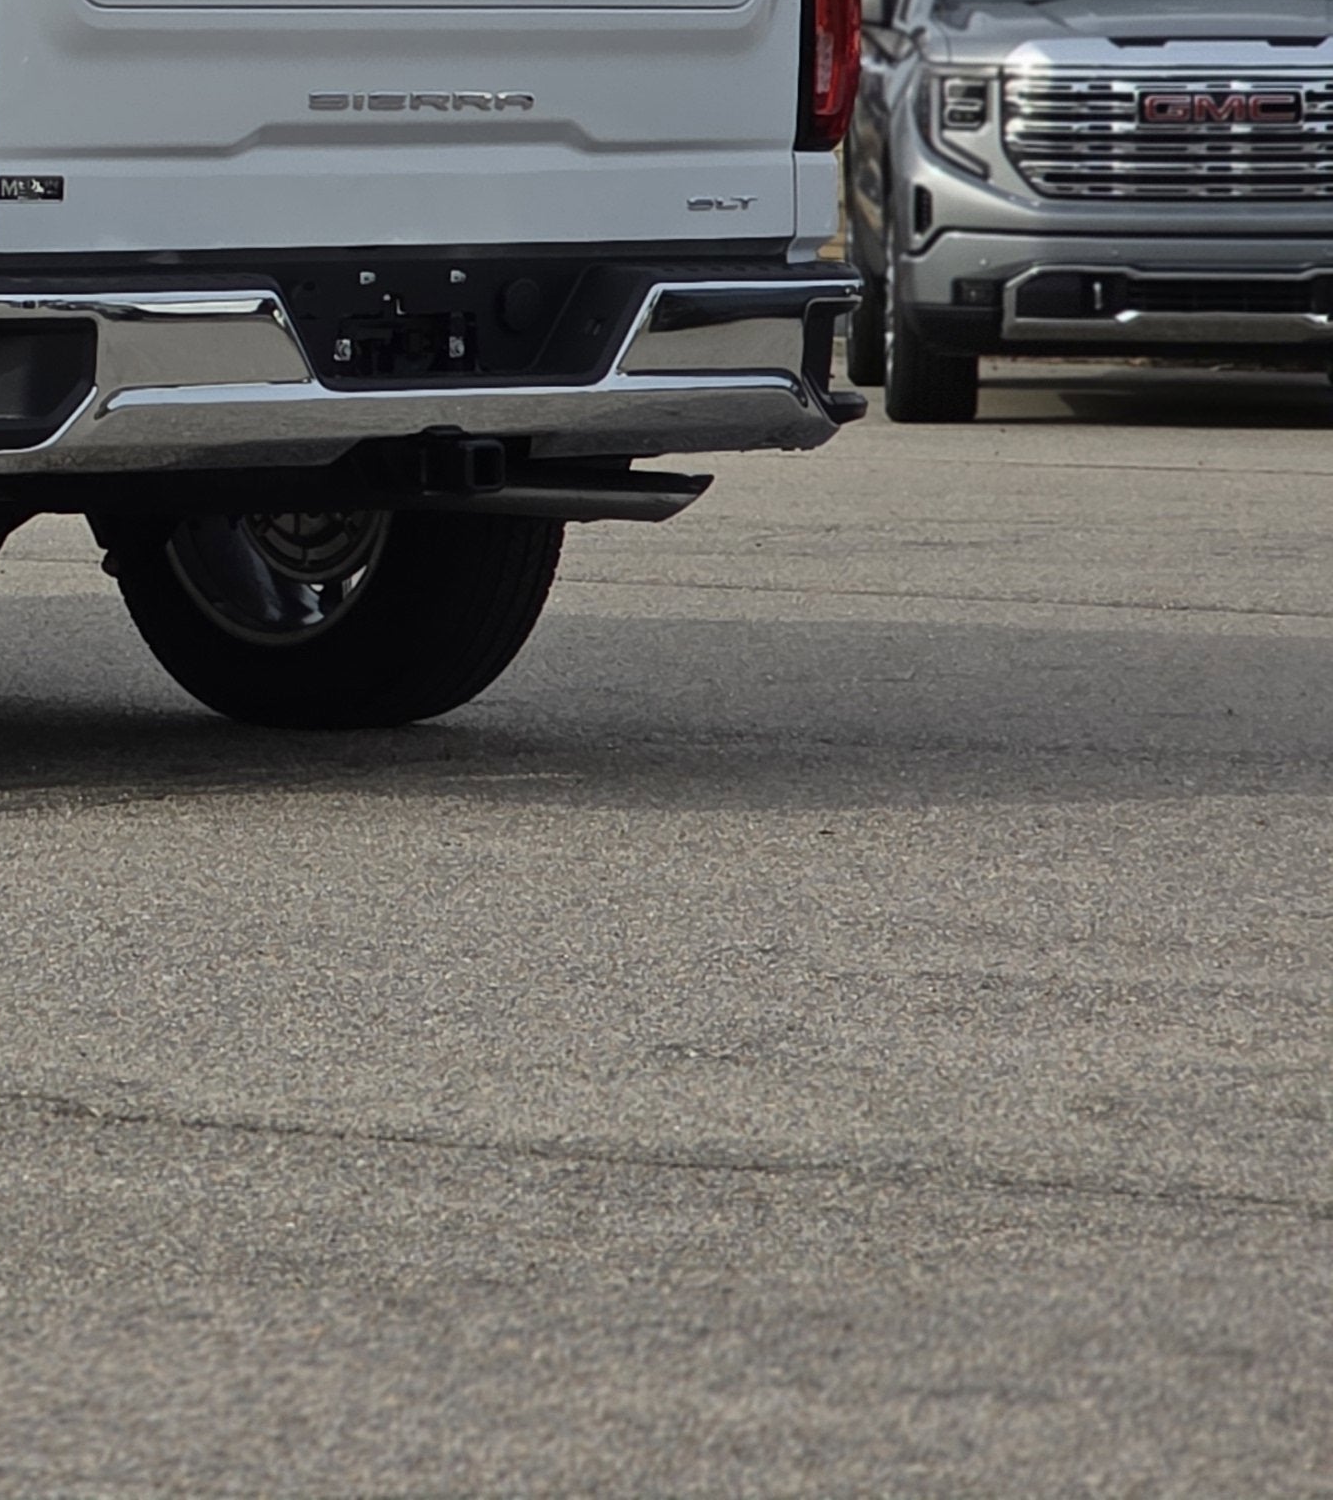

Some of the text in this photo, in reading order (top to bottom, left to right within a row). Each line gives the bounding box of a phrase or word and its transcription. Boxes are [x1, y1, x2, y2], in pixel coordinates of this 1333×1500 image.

[308, 91, 535, 111] SIERRA
[1144, 94, 1295, 122] GMC
[687, 196, 758, 211] SLT
